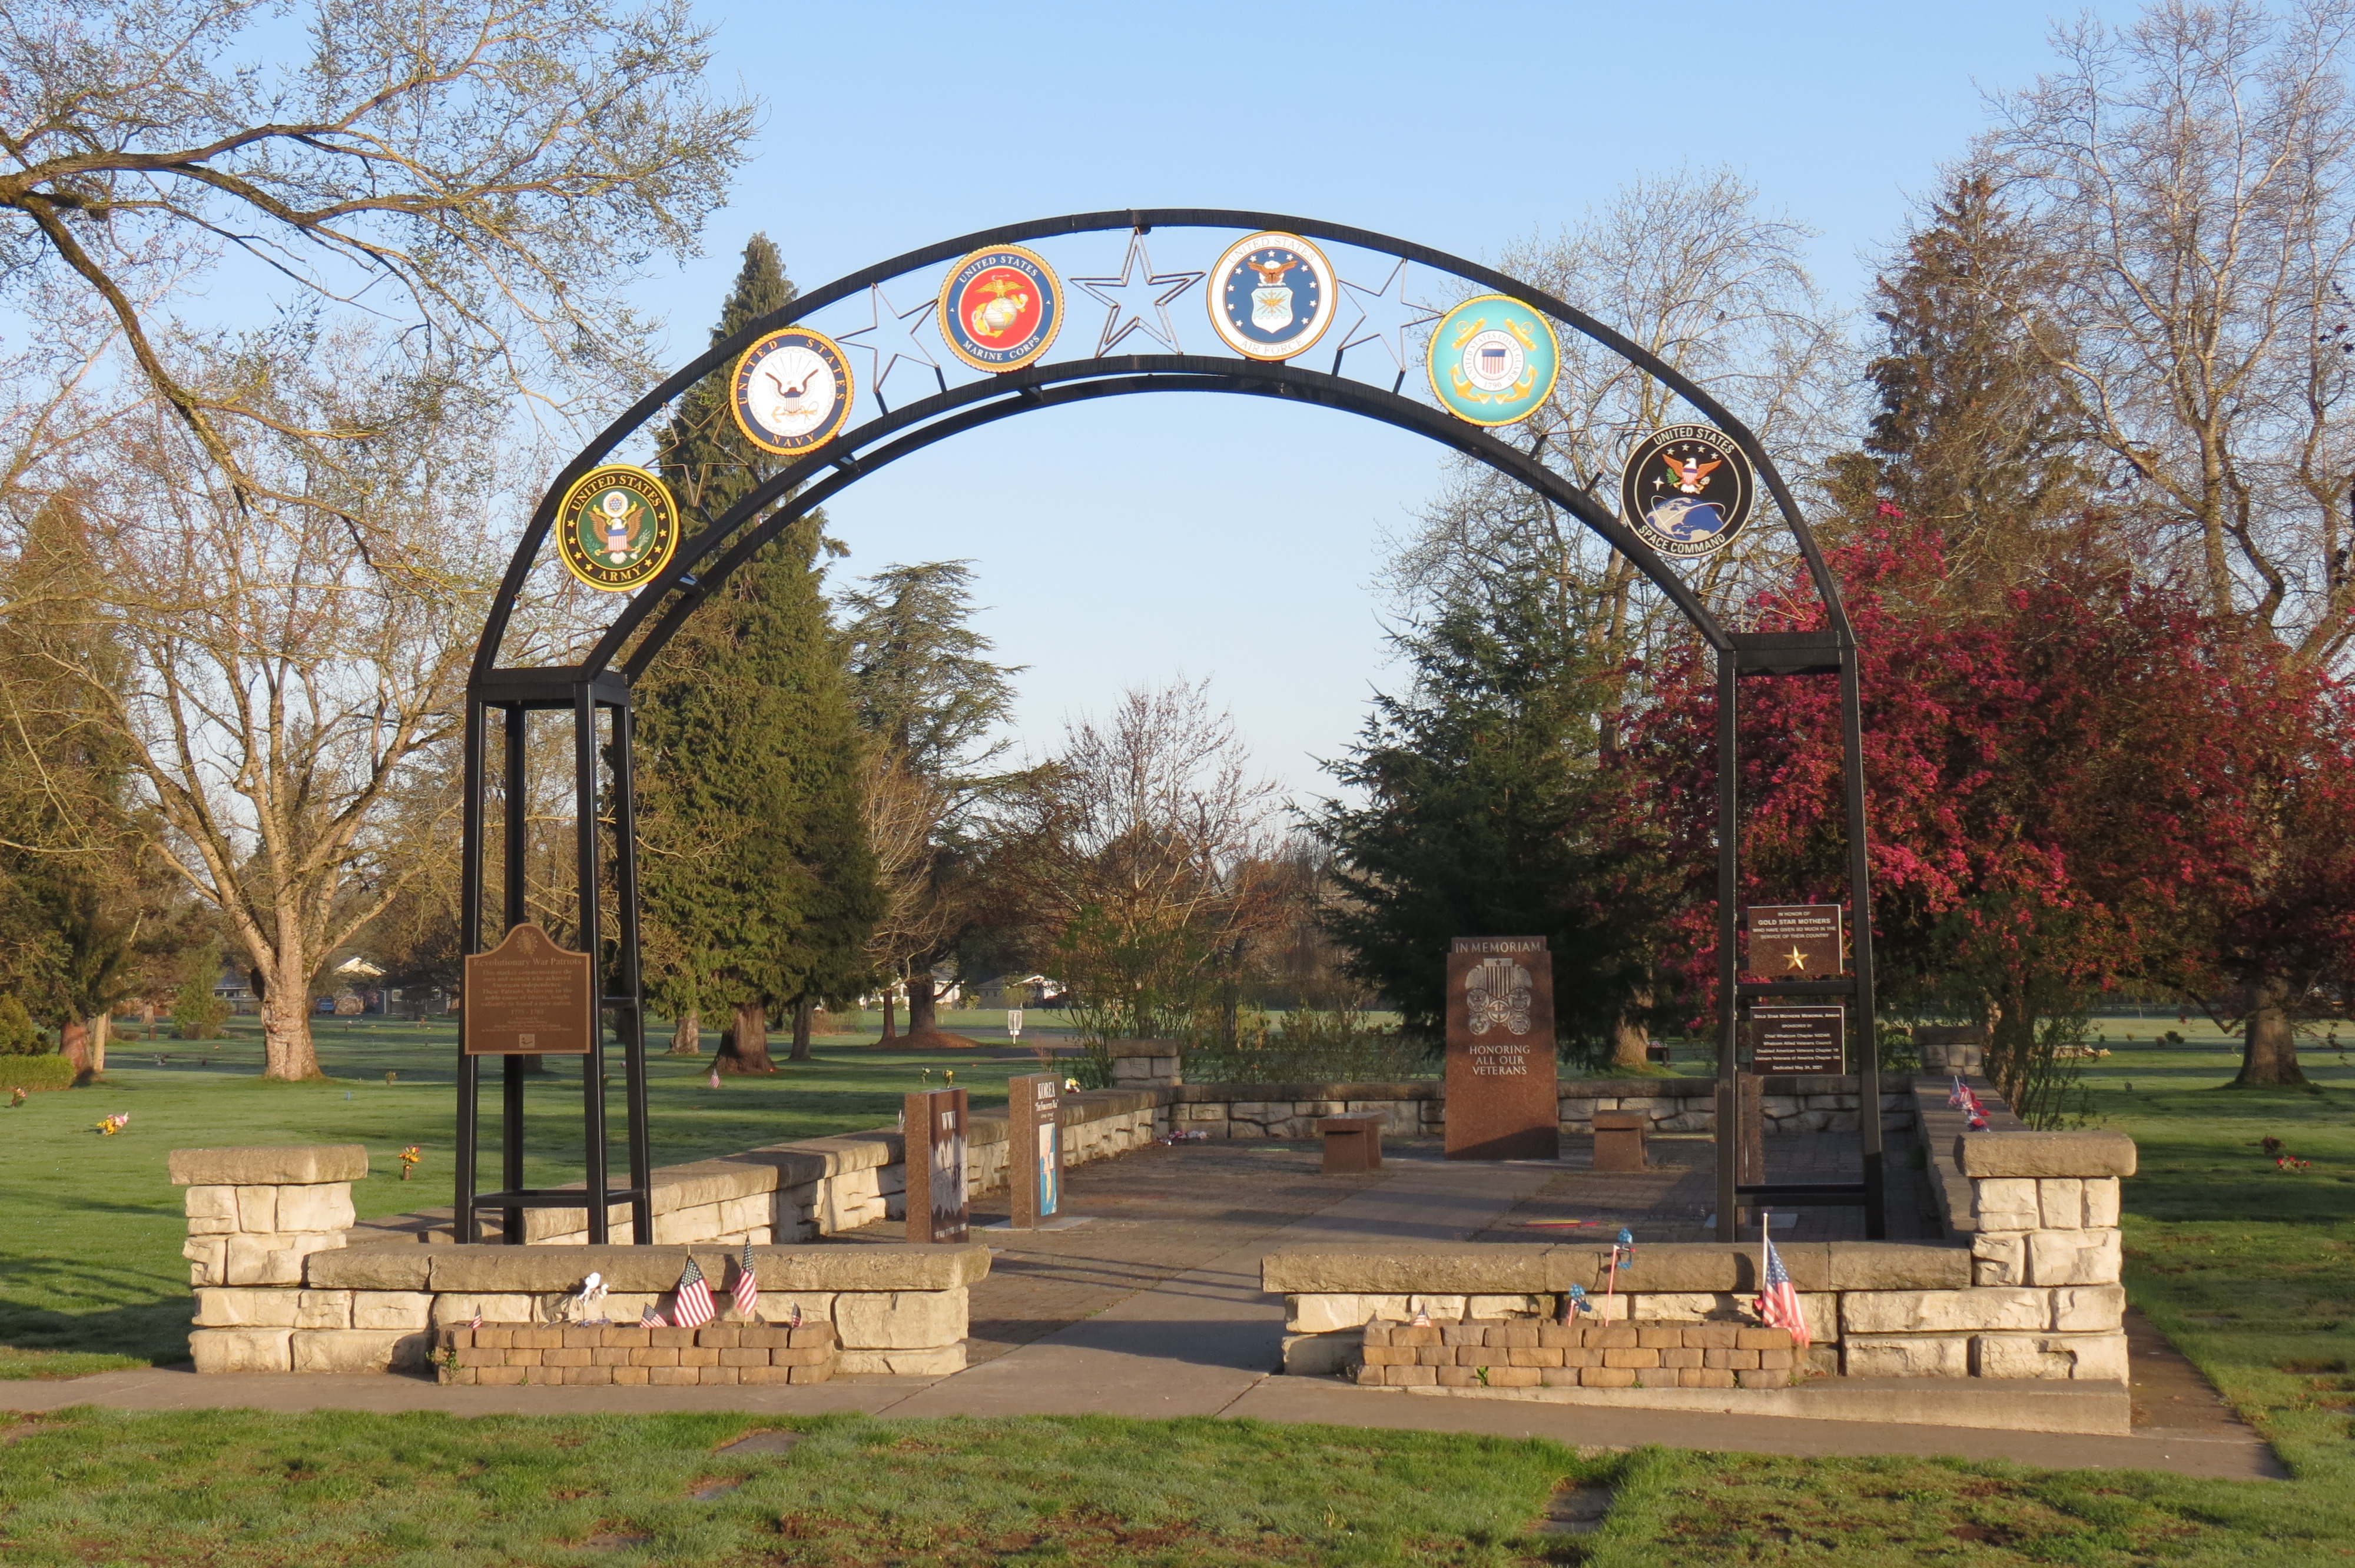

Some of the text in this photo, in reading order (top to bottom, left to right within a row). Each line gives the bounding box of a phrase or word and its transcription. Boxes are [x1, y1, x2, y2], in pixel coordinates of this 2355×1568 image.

[1228, 237, 1316, 264] UNITED STATES
[958, 255, 1039, 284] UNITED STATES
[963, 335, 1040, 361] MARINE CORPS
[1240, 337, 1305, 355] AIR FORCE
[1465, 333, 1522, 381] UNITED STATES COAST GUARD
[738, 338, 845, 406] UNITED STATES
[1484, 381, 1502, 389] 1790
[771, 432, 814, 447] NAVY
[1653, 427, 1736, 454] UNITED STATES
[570, 474, 662, 511] UNITED STATES
[1638, 524, 1726, 554] SPACE COMMAND
[598, 565, 642, 582] ARMY
[1455, 941, 1541, 954] IN MEMORIAM
[473, 958, 530, 968] Revolutionary
[550, 957, 582, 965] Patriots
[1470, 1045, 1531, 1055] HONORING
[1475, 1055, 1525, 1065] ALL OUR
[1472, 1065, 1528, 1075] VETERANS
[1037, 1081, 1056, 1099] KOREA
[941, 1111, 956, 1130] WWI
